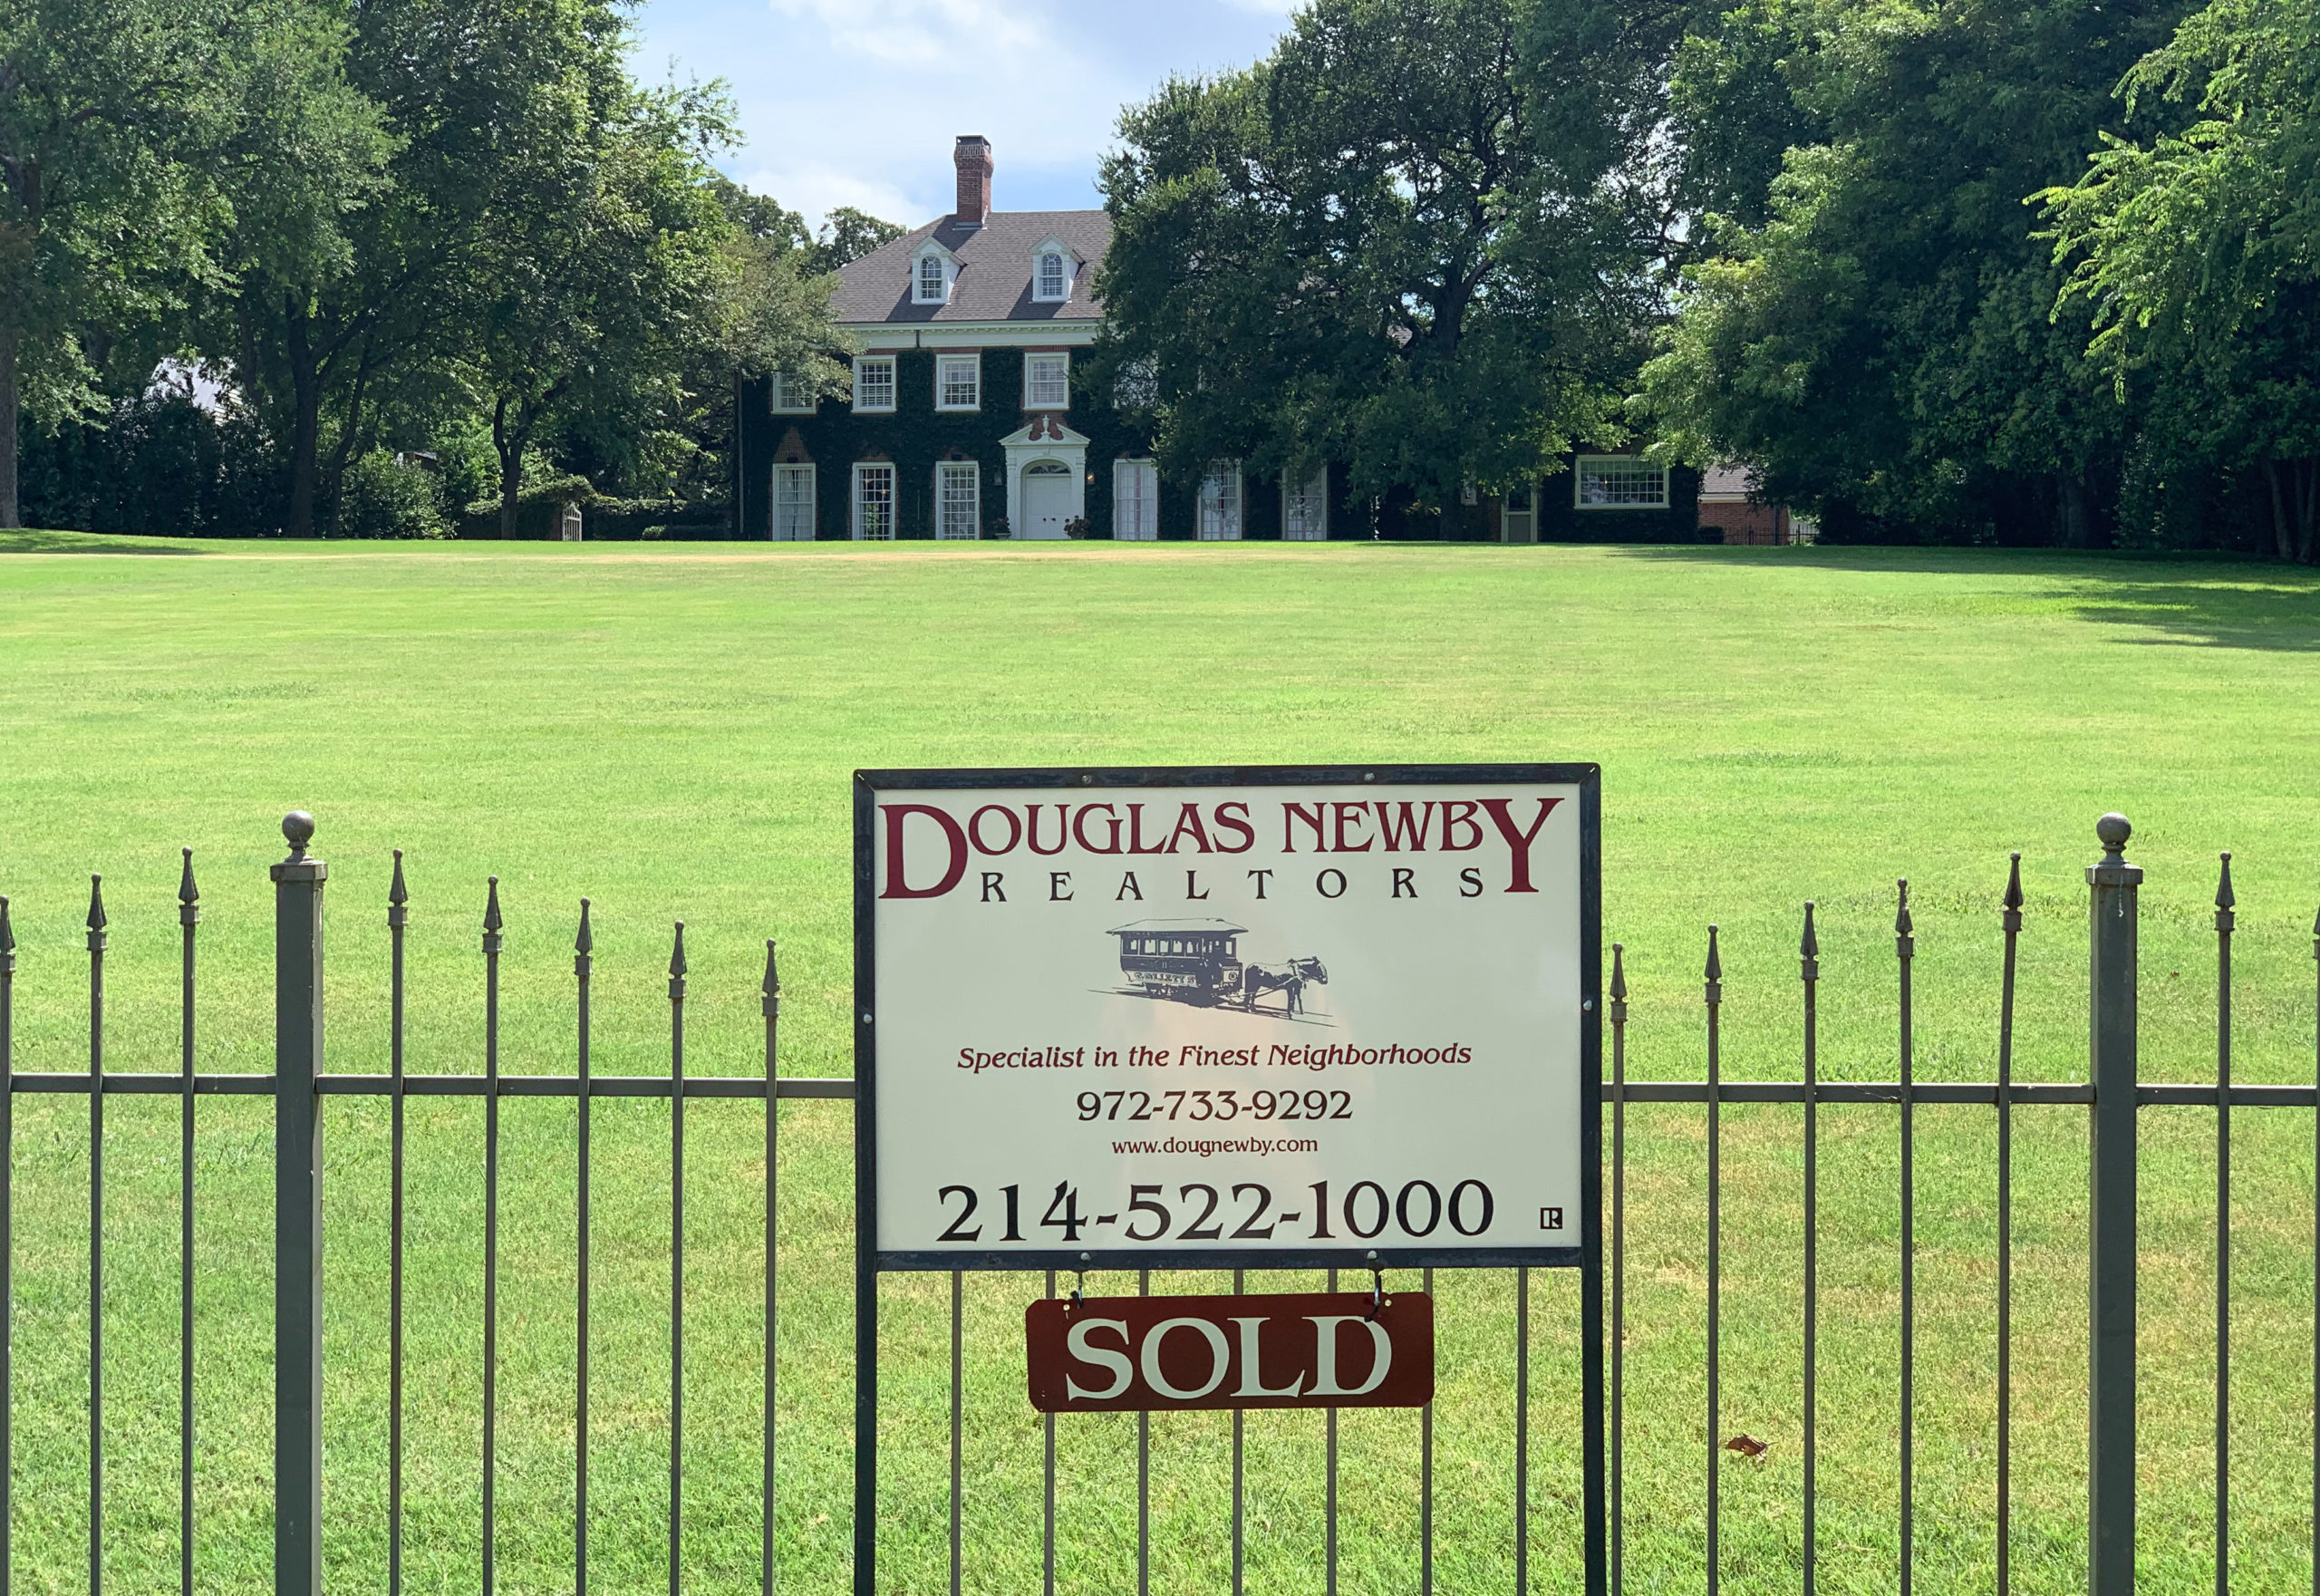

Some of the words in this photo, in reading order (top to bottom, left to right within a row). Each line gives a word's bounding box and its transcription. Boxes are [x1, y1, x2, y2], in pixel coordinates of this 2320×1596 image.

[878, 801, 1256, 900] DOUGLAS
[1281, 797, 1565, 893] NEWBY
[981, 867, 1484, 903] REALTORS
[958, 1044, 1086, 1075] Specialist
[1094, 1047, 1119, 1068] in
[1128, 1046, 1170, 1067] the
[1178, 1044, 1261, 1067] Finest
[1268, 1042, 1472, 1072] Neighborhoods
[1078, 1089, 1353, 1121] 972-733-9292
[1112, 1136, 1319, 1157] www.dougnewby.com
[935, 1179, 1494, 1243] 214-522-1000
[1065, 1316, 1393, 1401] SOLD
